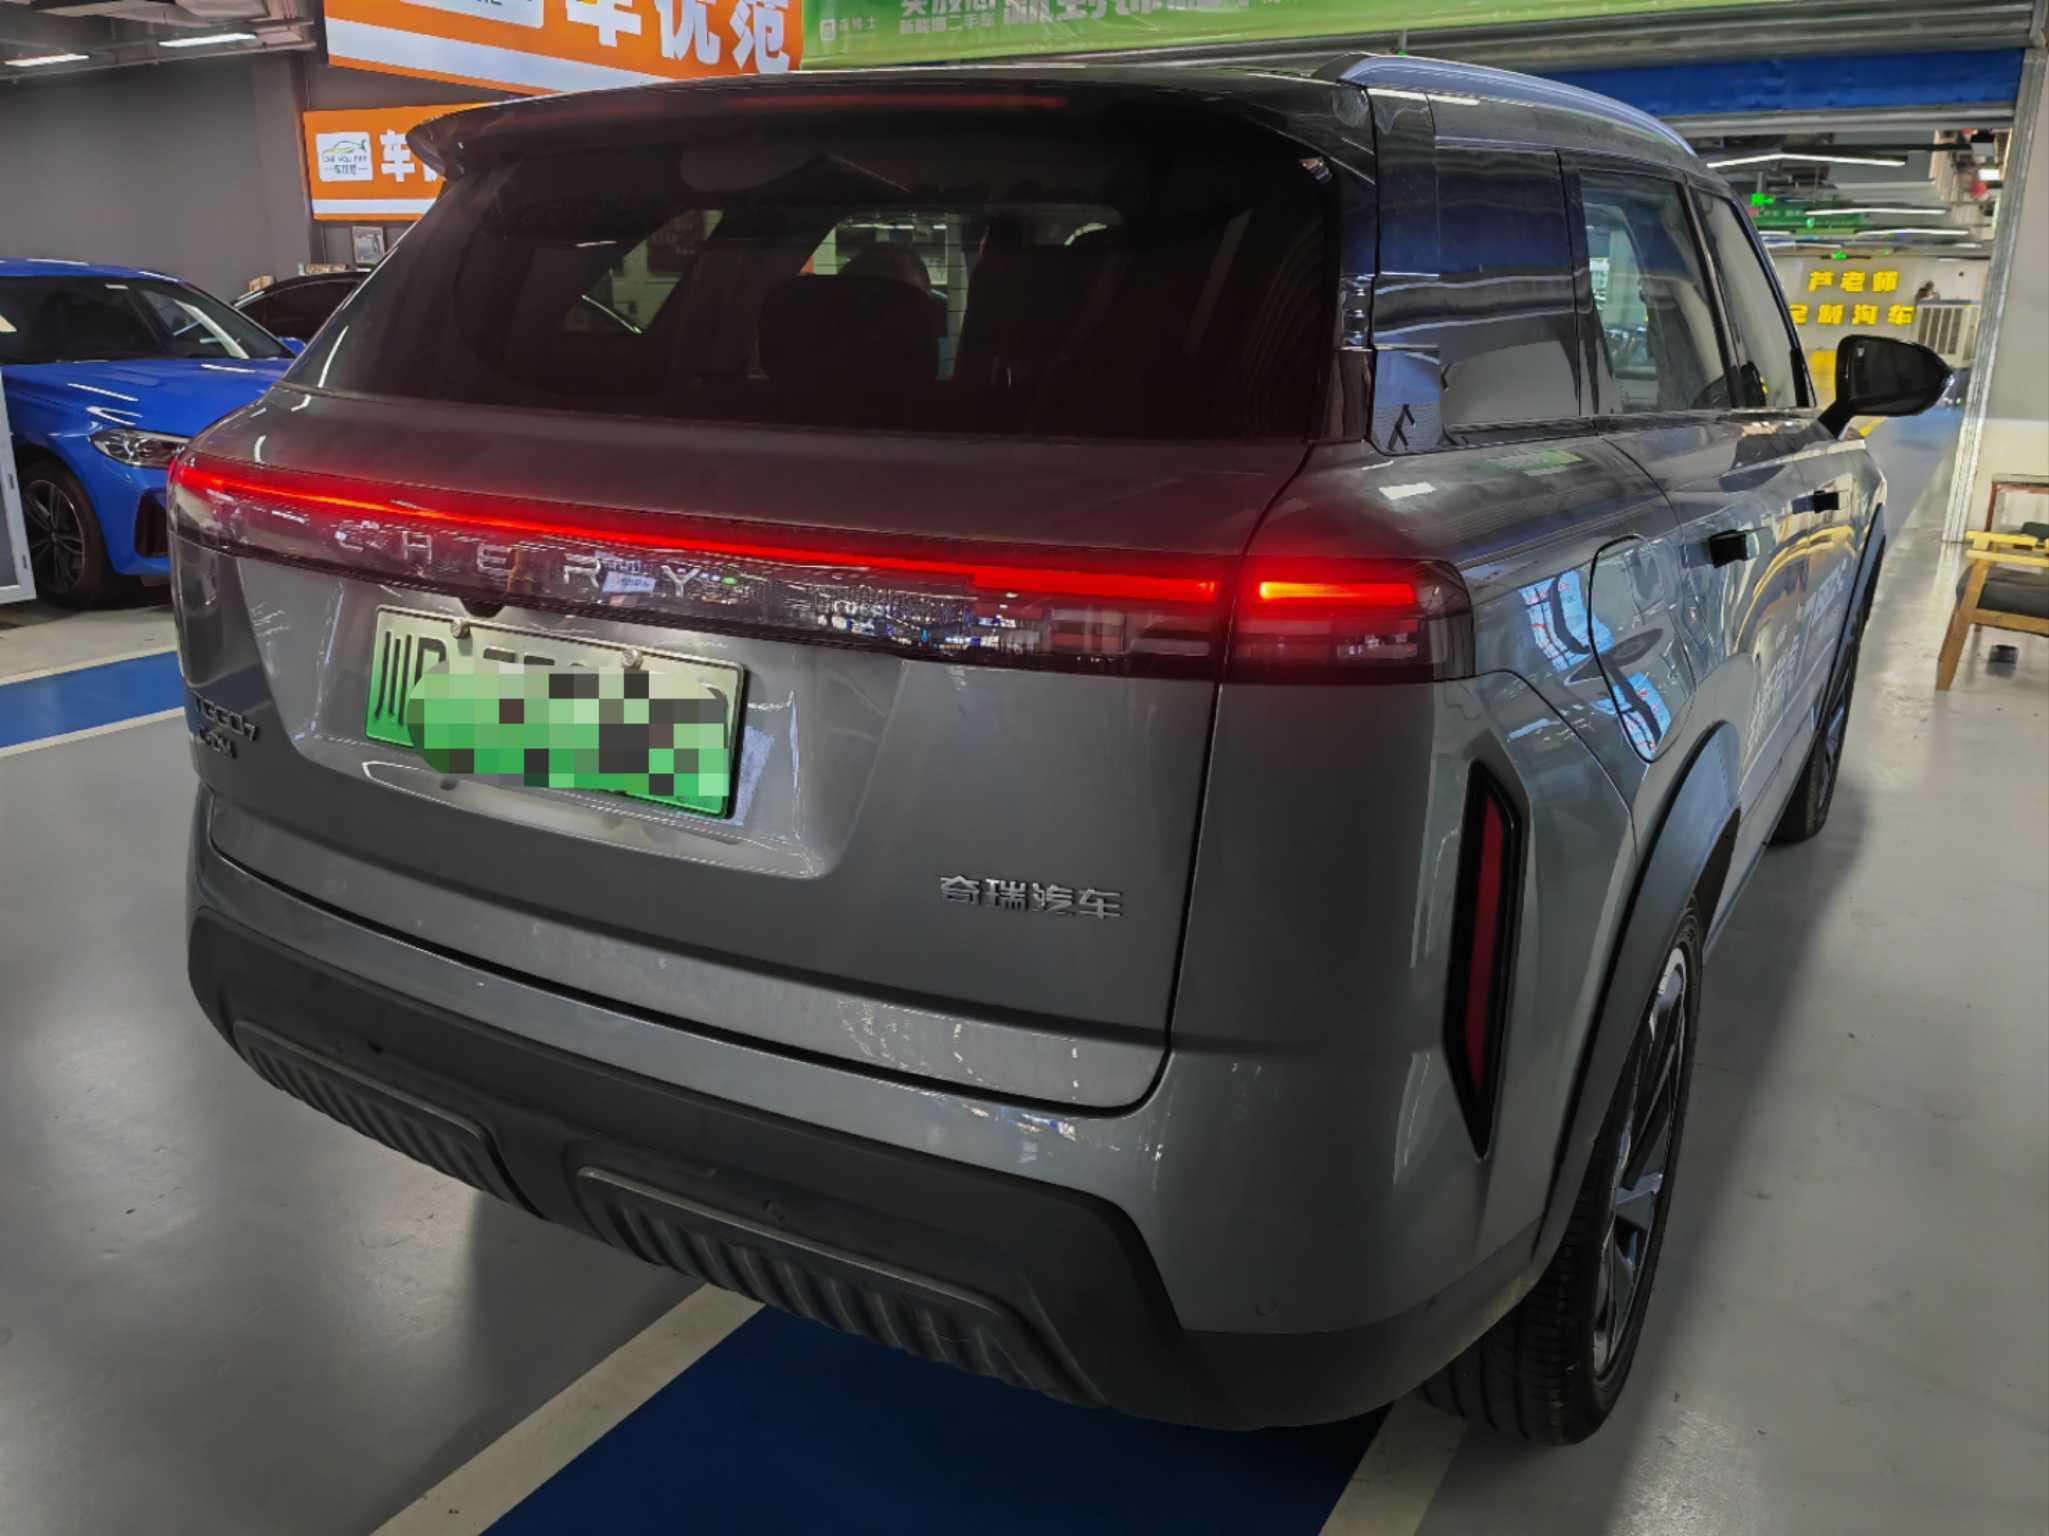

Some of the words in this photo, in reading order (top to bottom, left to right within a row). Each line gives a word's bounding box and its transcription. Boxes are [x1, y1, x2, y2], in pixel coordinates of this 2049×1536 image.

[380, 129, 438, 182] 车
[334, 519, 701, 598] CHERY
[939, 874, 1122, 921] 奇瑞汽车
